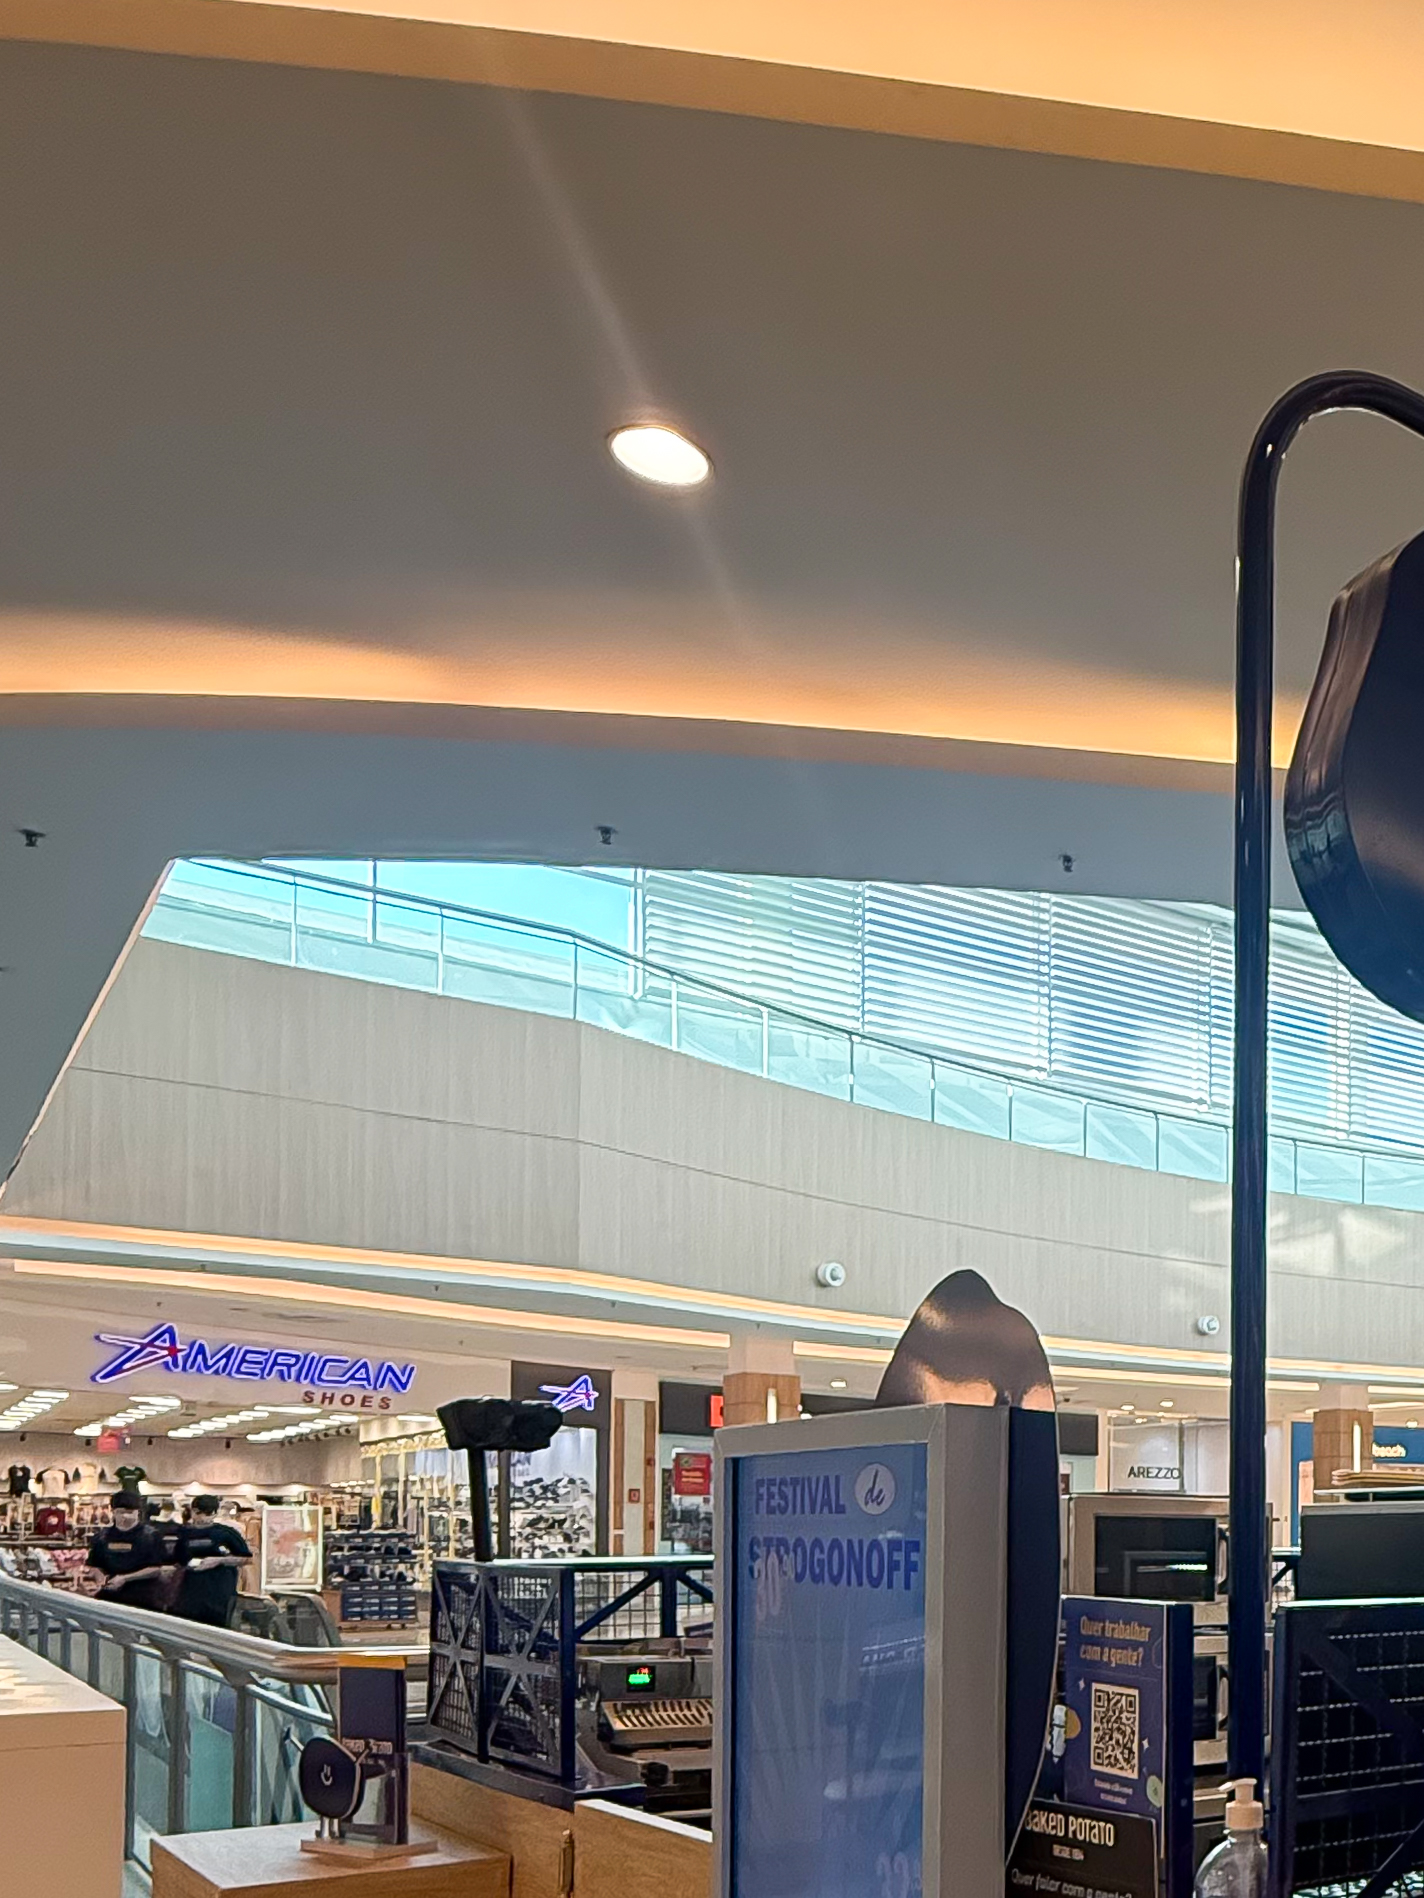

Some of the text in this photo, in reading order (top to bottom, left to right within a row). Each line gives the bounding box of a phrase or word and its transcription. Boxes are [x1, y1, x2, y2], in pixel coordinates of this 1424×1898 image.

[91, 1323, 415, 1392] AMERICAN
[303, 1390, 392, 1410] SHOES
[1127, 1466, 1181, 1479] AREZZO
[755, 1469, 885, 1515] FESTIVAL de
[749, 1536, 920, 1590] STROGONOFF
[1080, 1615, 1151, 1642] Quer trabalhar
[1080, 1645, 1143, 1668] com a gente?
[1011, 1868, 1034, 1885] Quer
[1036, 1874, 1060, 1892] falar
[1061, 1882, 1084, 1898] com
